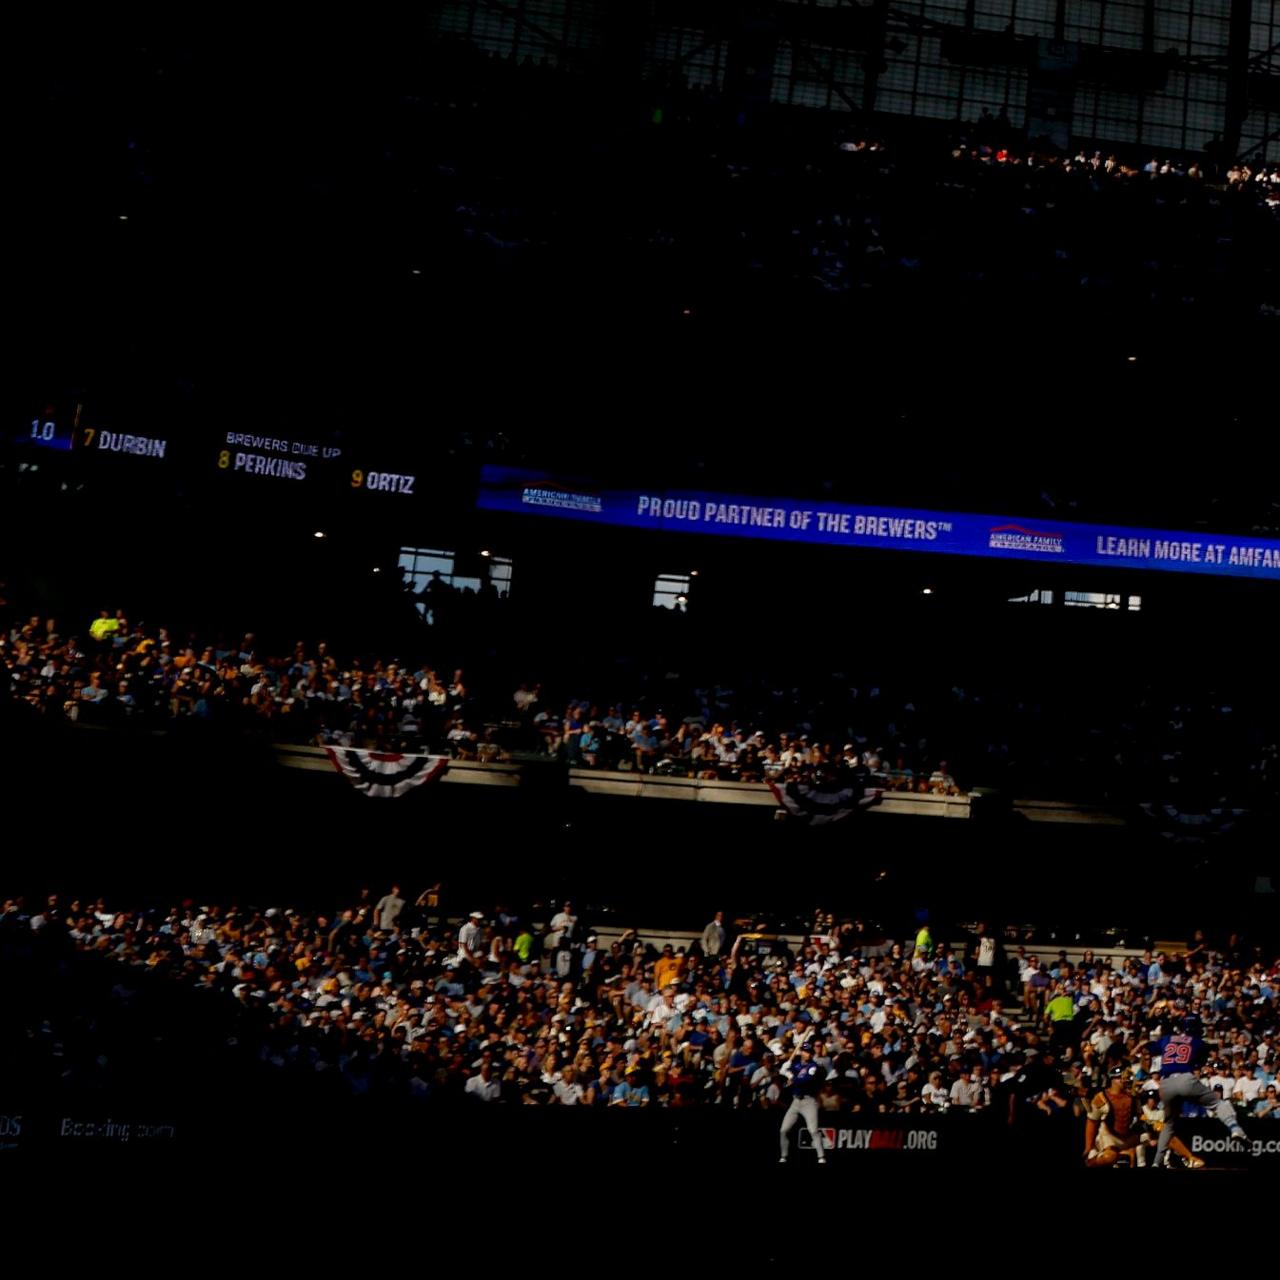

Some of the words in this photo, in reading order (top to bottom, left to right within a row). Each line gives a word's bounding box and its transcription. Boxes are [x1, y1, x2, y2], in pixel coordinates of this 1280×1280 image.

[83, 428, 96, 447] 7
[97, 429, 168, 459] DURBIN
[226, 431, 289, 453] BREWERS
[322, 446, 342, 459] UP
[217, 450, 231, 469] 8
[234, 452, 308, 481] PERKINS
[350, 469, 364, 489] 9
[366, 470, 416, 495] ORTIZ
[637, 495, 701, 521] PROUD
[704, 501, 786, 529] PARTNER
[789, 510, 813, 531] OF
[817, 512, 850, 534] THE
[1096, 535, 1148, 557] LEARN
[1154, 541, 1200, 563] MORE
[1204, 545, 1226, 564] AT
[1161, 1043, 1193, 1065] 29
